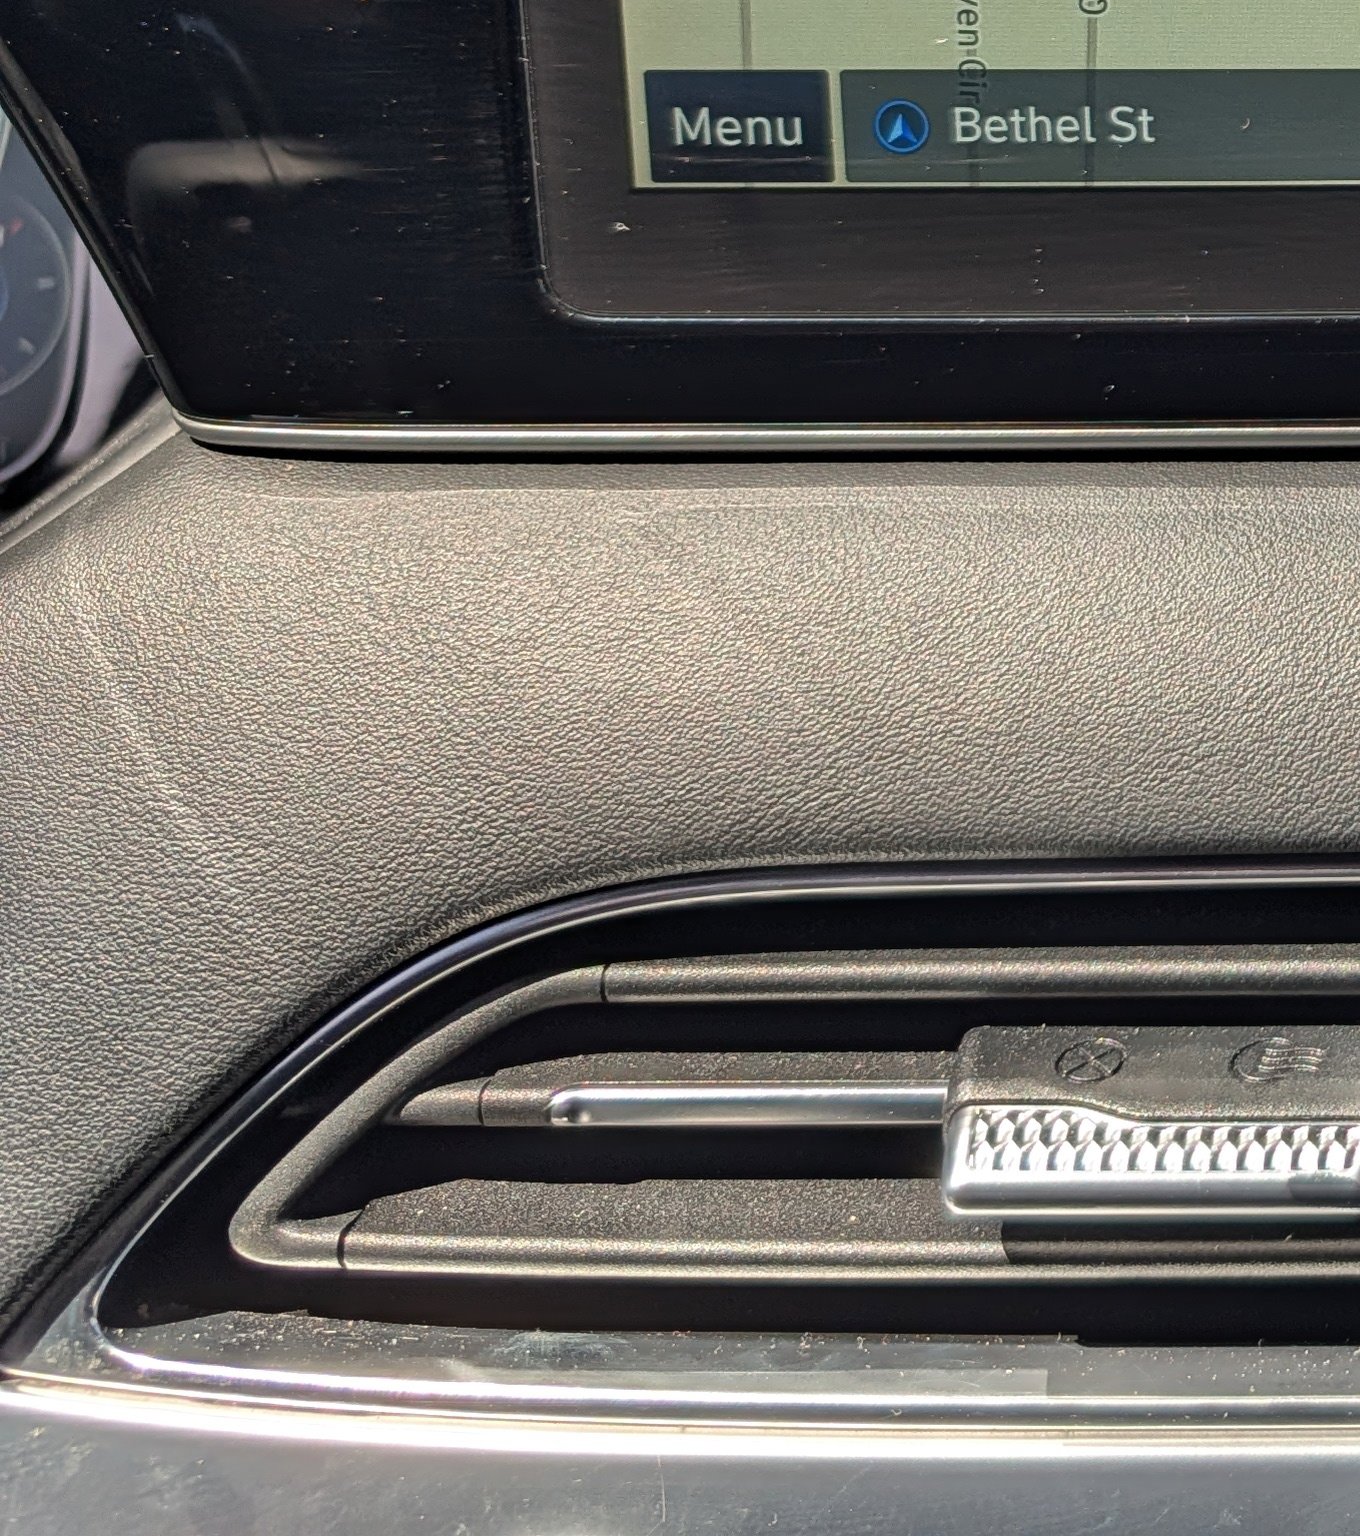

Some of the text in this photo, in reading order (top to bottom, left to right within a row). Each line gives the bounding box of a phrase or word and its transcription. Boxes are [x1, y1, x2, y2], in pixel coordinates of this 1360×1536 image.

[957, 59, 988, 104] Cir
[672, 107, 803, 146] Menu
[953, 107, 1156, 144] Bethel St
